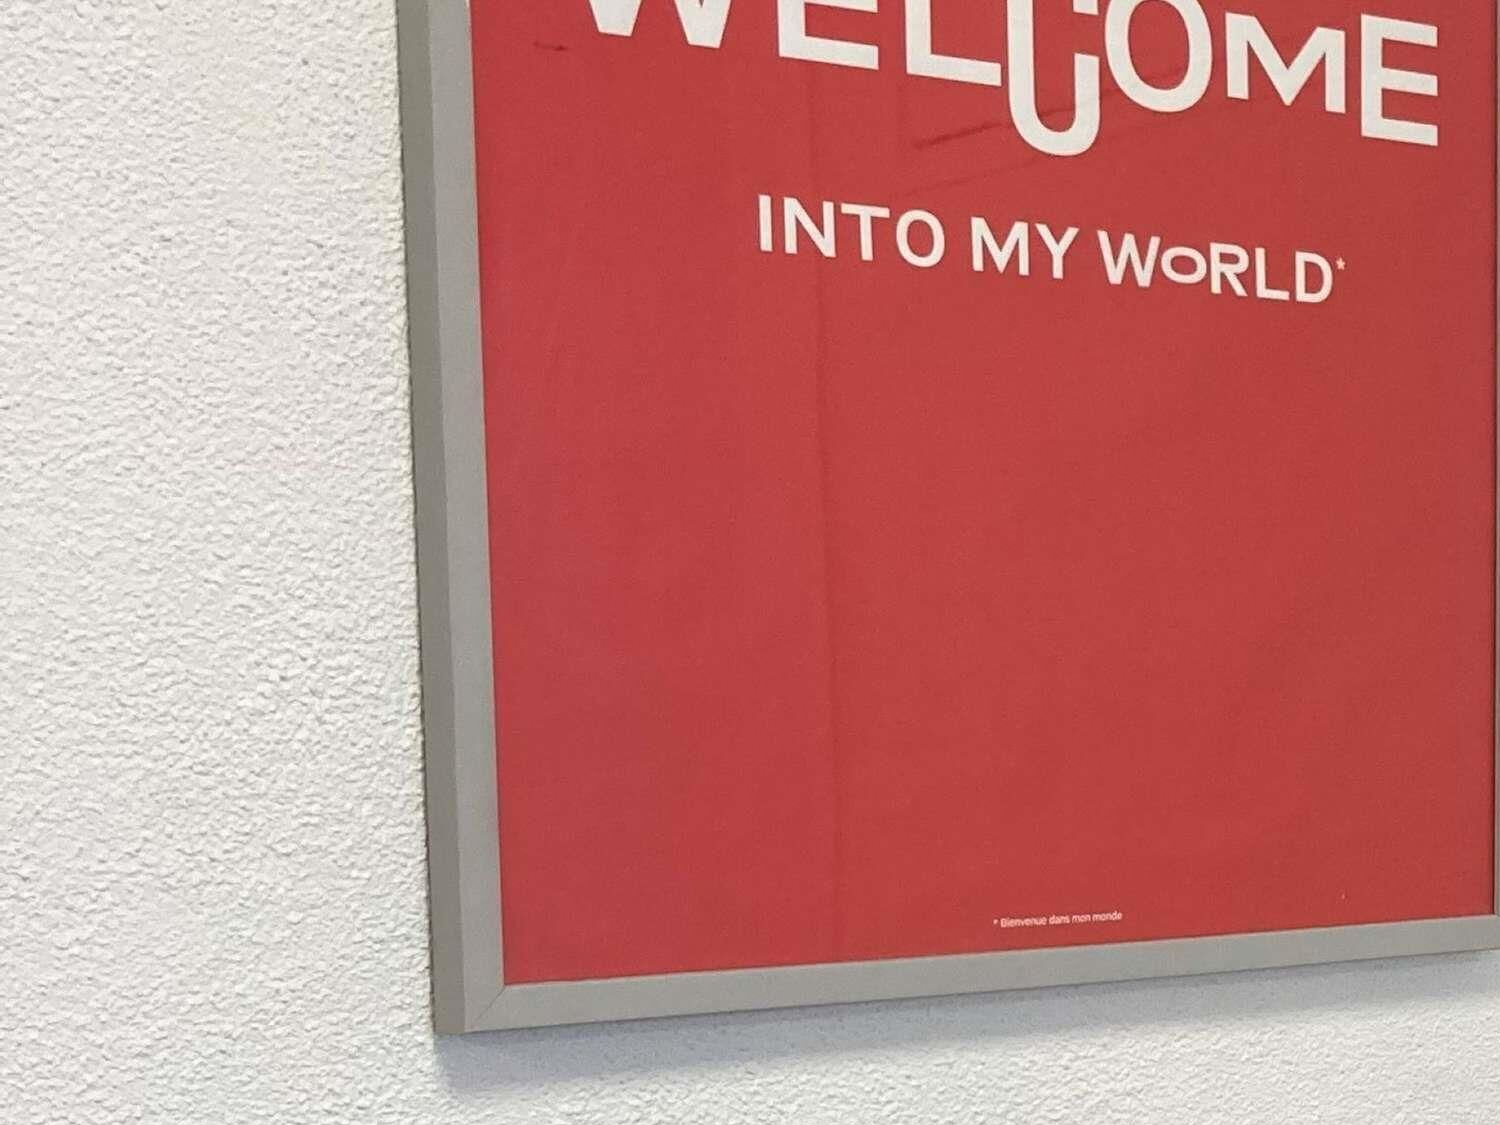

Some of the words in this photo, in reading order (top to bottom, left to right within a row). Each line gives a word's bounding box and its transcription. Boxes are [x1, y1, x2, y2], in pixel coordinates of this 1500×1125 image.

[758, 194, 945, 268] INTO
[970, 216, 1079, 279] MY
[1000, 916, 1047, 928] Bienvenue
[1048, 914, 1070, 925] dans
[1071, 913, 1091, 923] mon
[1092, 910, 1122, 921] monde
